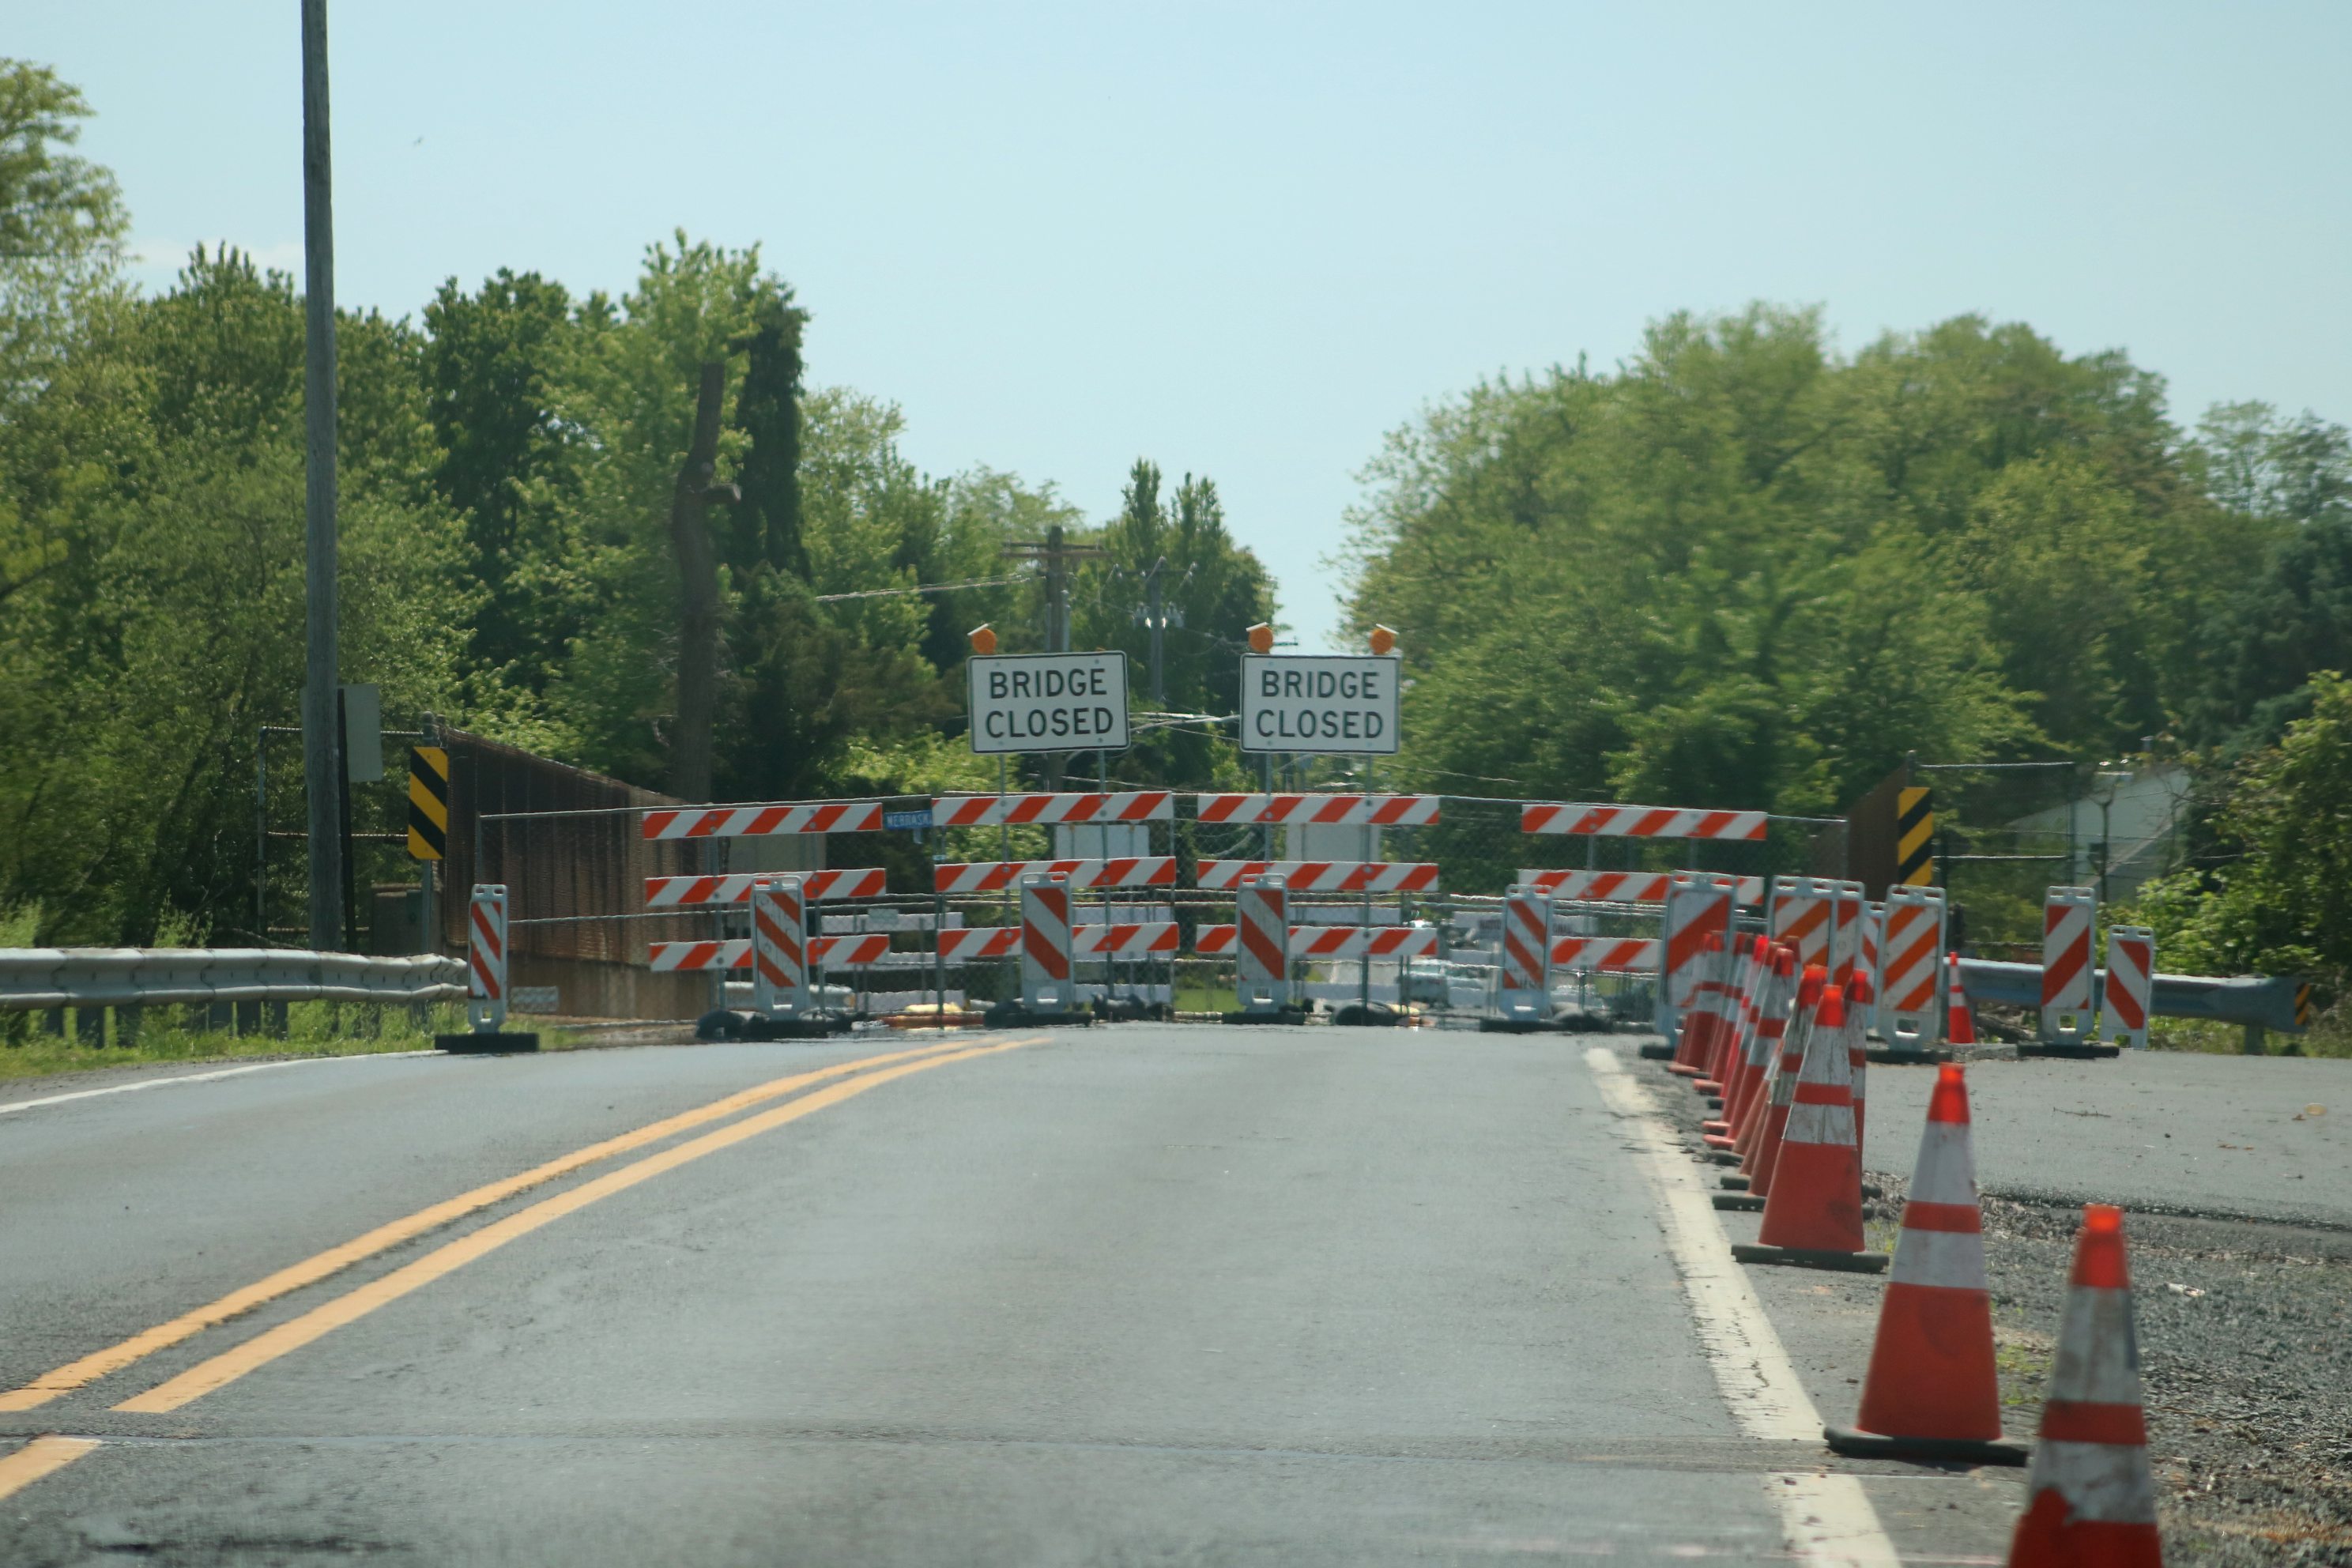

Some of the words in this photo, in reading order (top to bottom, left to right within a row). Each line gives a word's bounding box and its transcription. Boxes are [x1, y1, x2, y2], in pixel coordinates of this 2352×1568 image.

[989, 668, 1107, 699] BRIDGE
[1261, 669, 1380, 699] BRIDGE
[985, 707, 1114, 738] CLOSED
[1257, 708, 1384, 739] CLOSED
